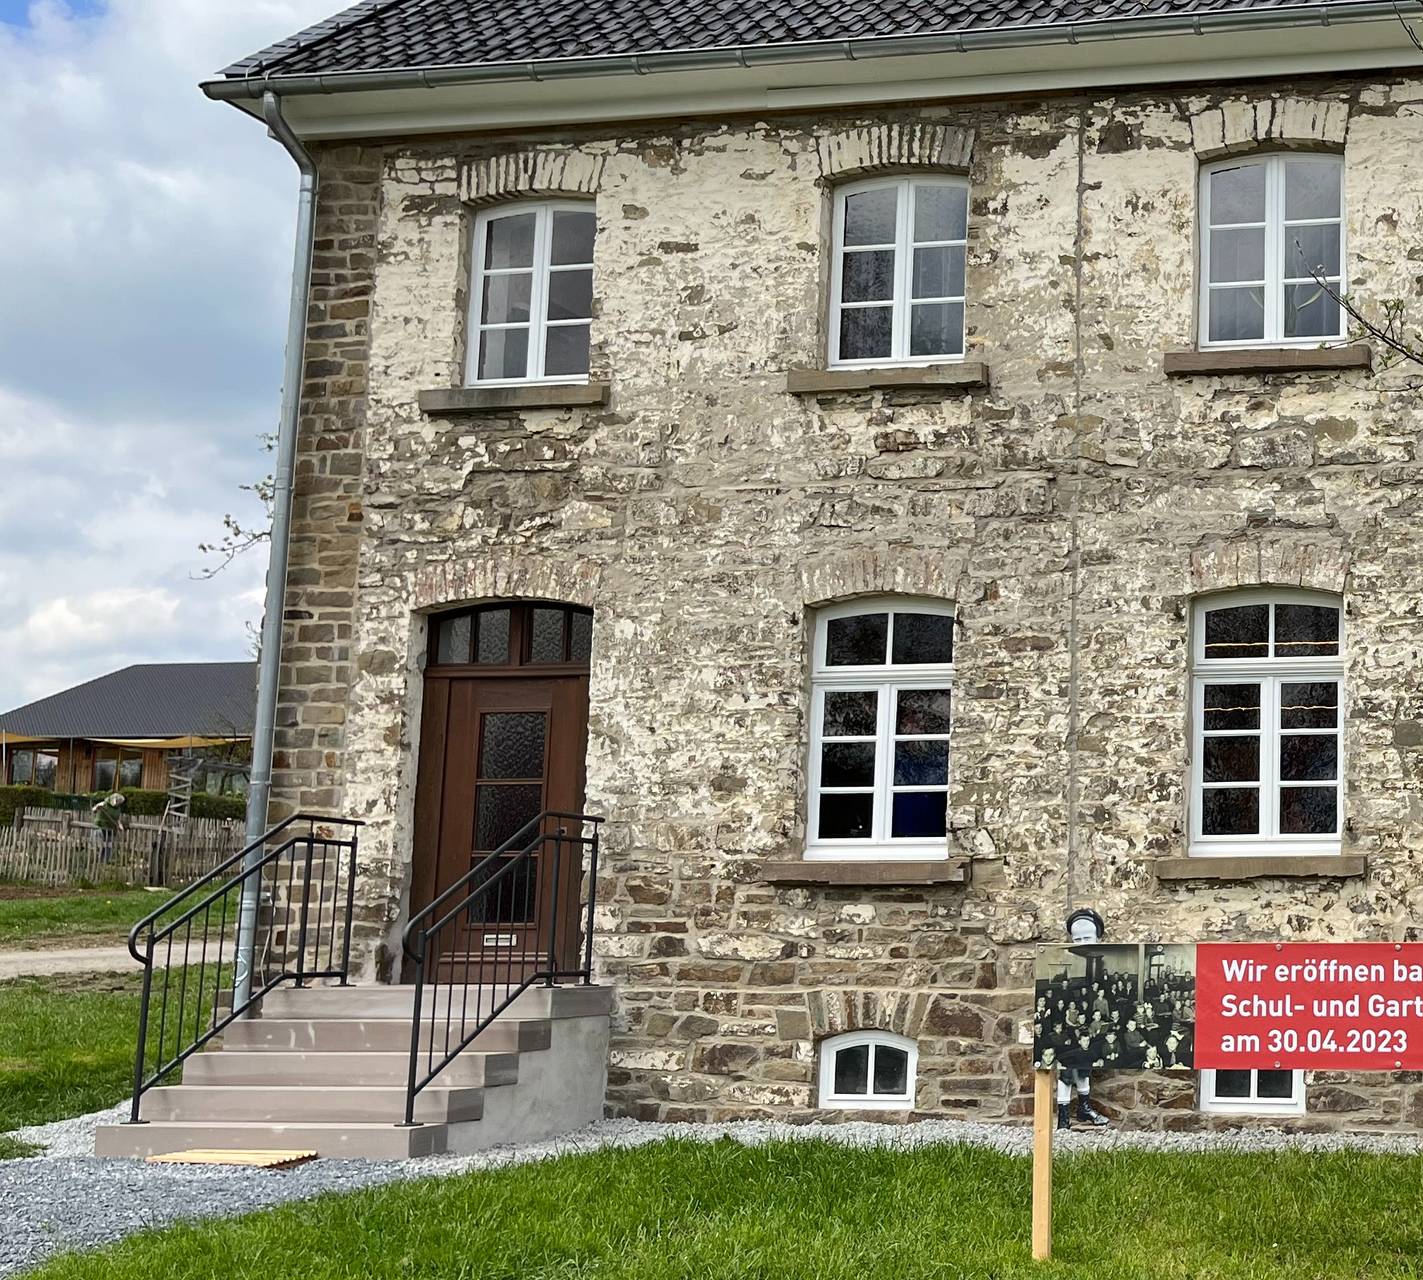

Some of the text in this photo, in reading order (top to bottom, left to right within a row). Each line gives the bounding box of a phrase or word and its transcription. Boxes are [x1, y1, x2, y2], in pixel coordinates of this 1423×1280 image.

[1221, 959, 1268, 982] Wir
[1274, 959, 1385, 982] eröffnen
[1221, 994, 1305, 1018] Schul-
[1312, 994, 1360, 1018] und
[1220, 1029, 1408, 1053] am 30.04.2023
